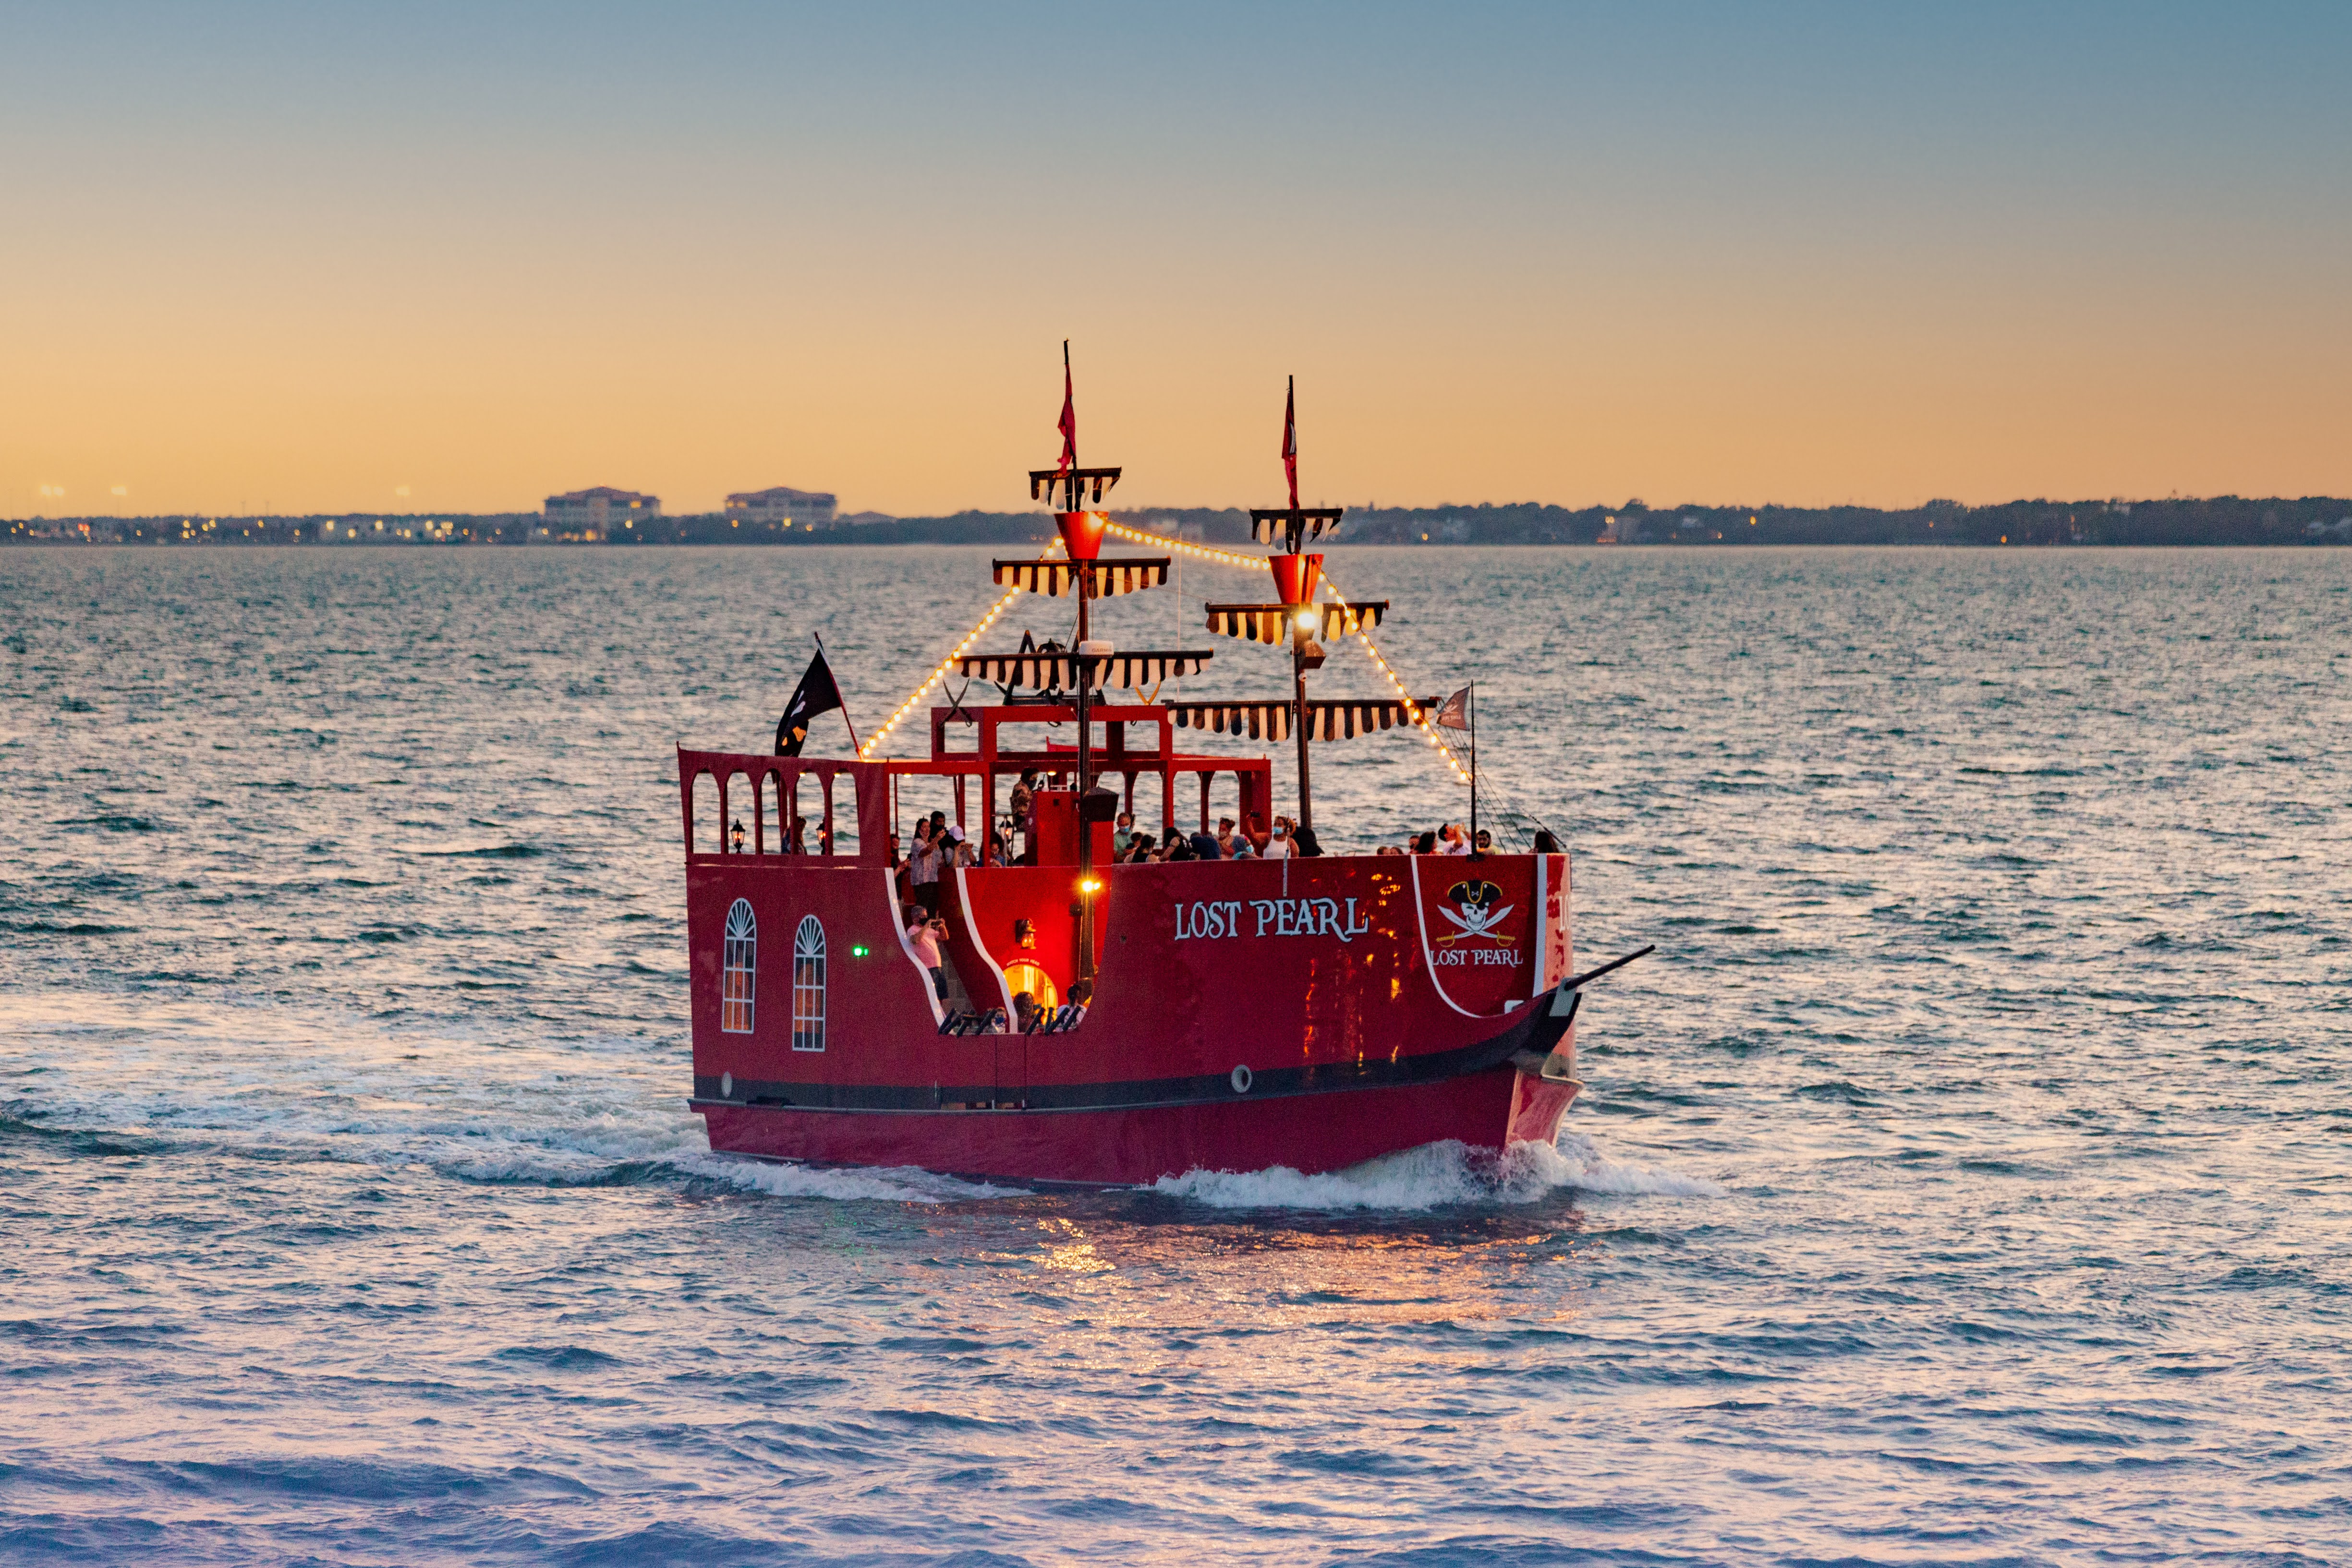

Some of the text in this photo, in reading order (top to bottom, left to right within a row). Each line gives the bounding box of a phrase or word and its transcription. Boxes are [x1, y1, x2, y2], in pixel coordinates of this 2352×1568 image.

[1174, 897, 1369, 942] LOST PEARL
[1430, 949, 1523, 968] LOST PEARL
